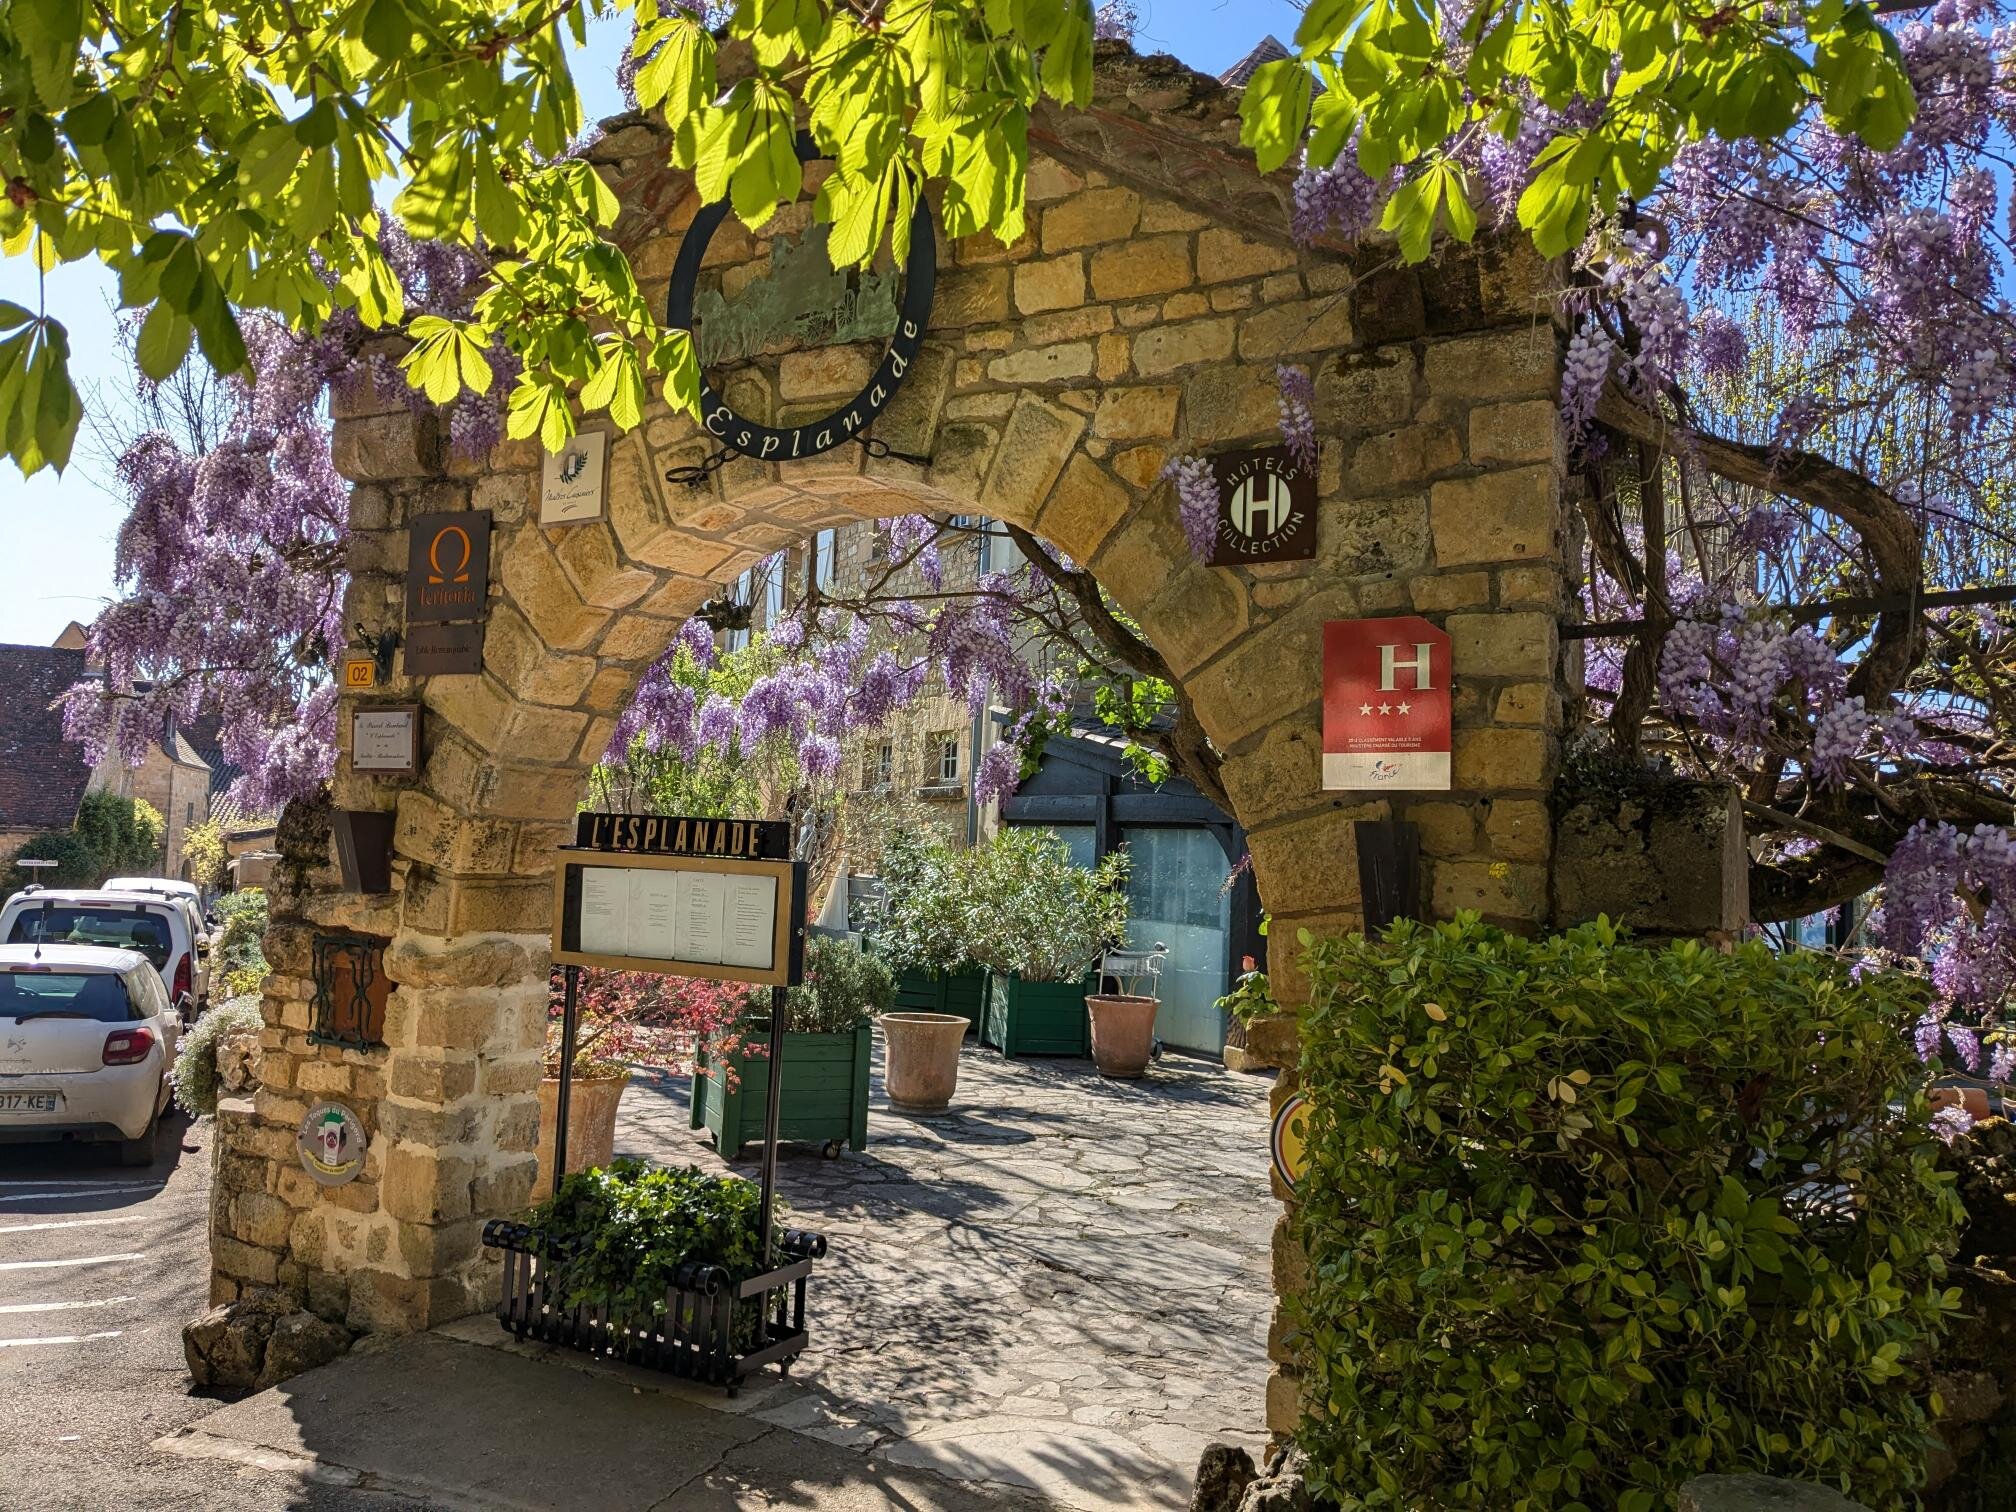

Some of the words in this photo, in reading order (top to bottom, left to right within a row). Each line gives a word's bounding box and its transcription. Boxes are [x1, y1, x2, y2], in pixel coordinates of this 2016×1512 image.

[699, 319, 919, 459] 'Esplanade
[1217, 512, 1304, 554] COLLECTION
[352, 666, 368, 682] 02
[1376, 642, 1437, 692] H
[592, 816, 760, 857] L'ESPLANADE
[302, 1120, 311, 1136] Les
[309, 1107, 331, 1121] Toques
[331, 1106, 340, 1115] du
[340, 1109, 363, 1143] Périgord
